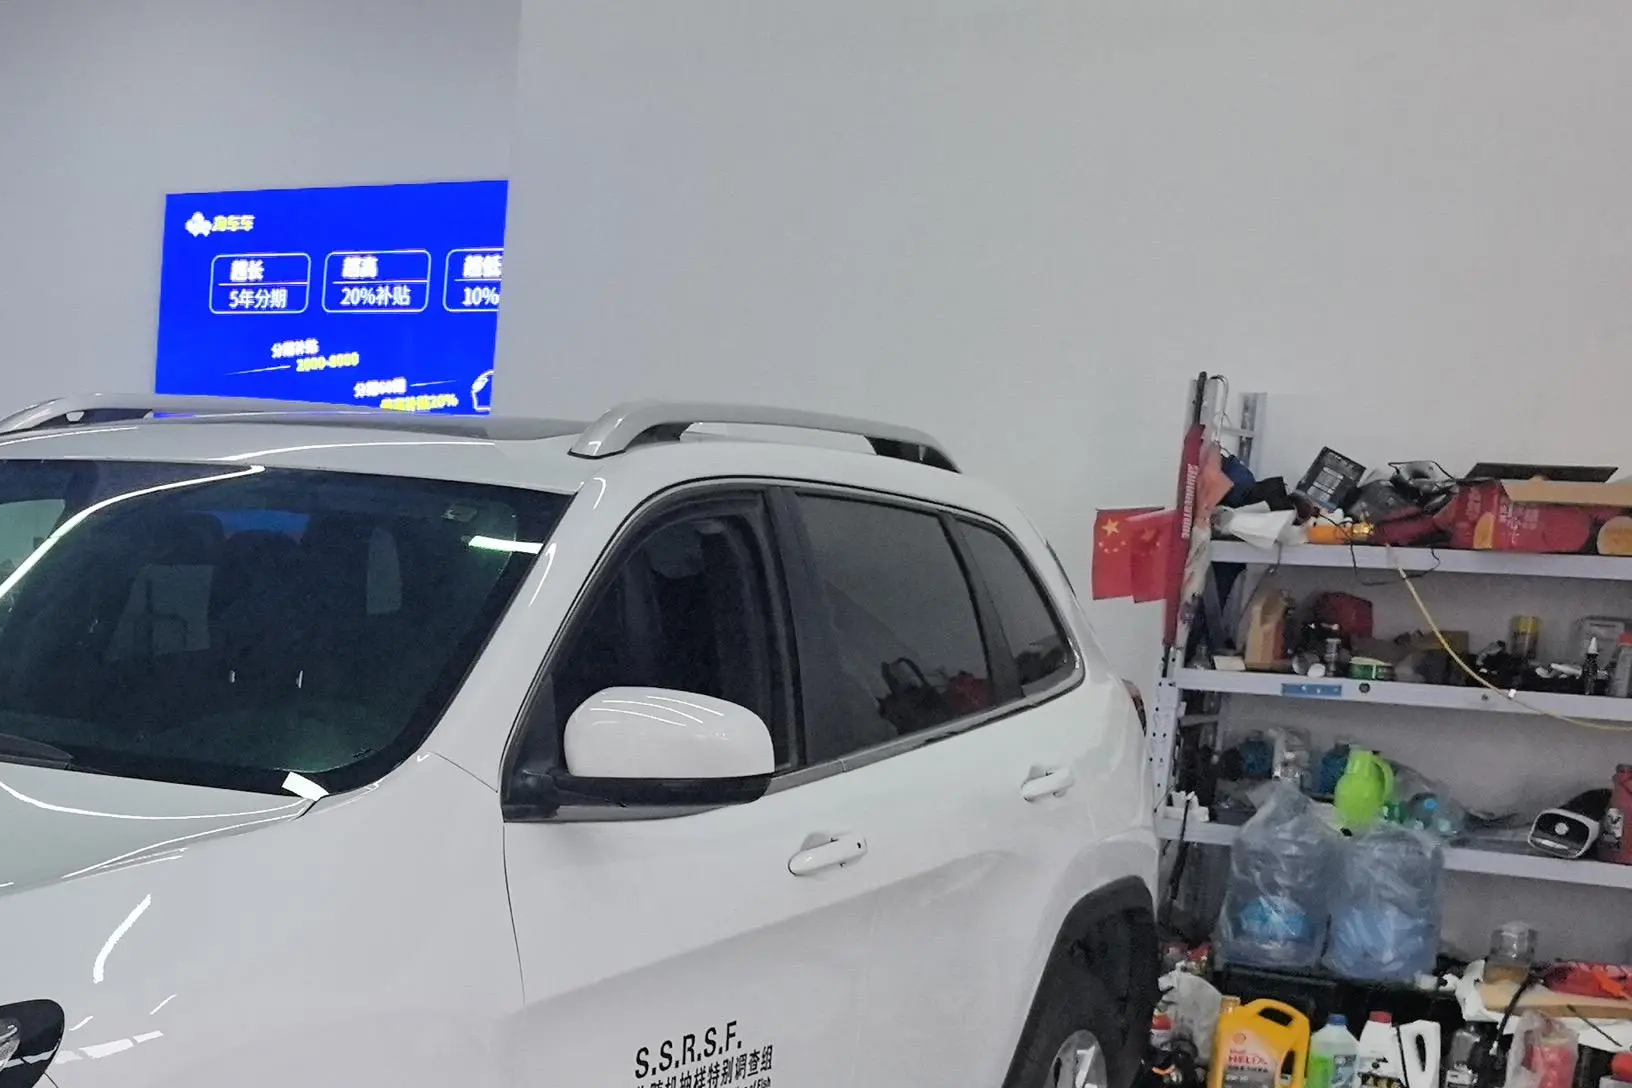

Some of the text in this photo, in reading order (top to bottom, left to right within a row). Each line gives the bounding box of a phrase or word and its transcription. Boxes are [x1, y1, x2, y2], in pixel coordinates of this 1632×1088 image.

[229, 287, 288, 309] 5年分期
[340, 284, 411, 307] 20%补贴
[635, 1020, 742, 1079] S.S.R.S.F.
